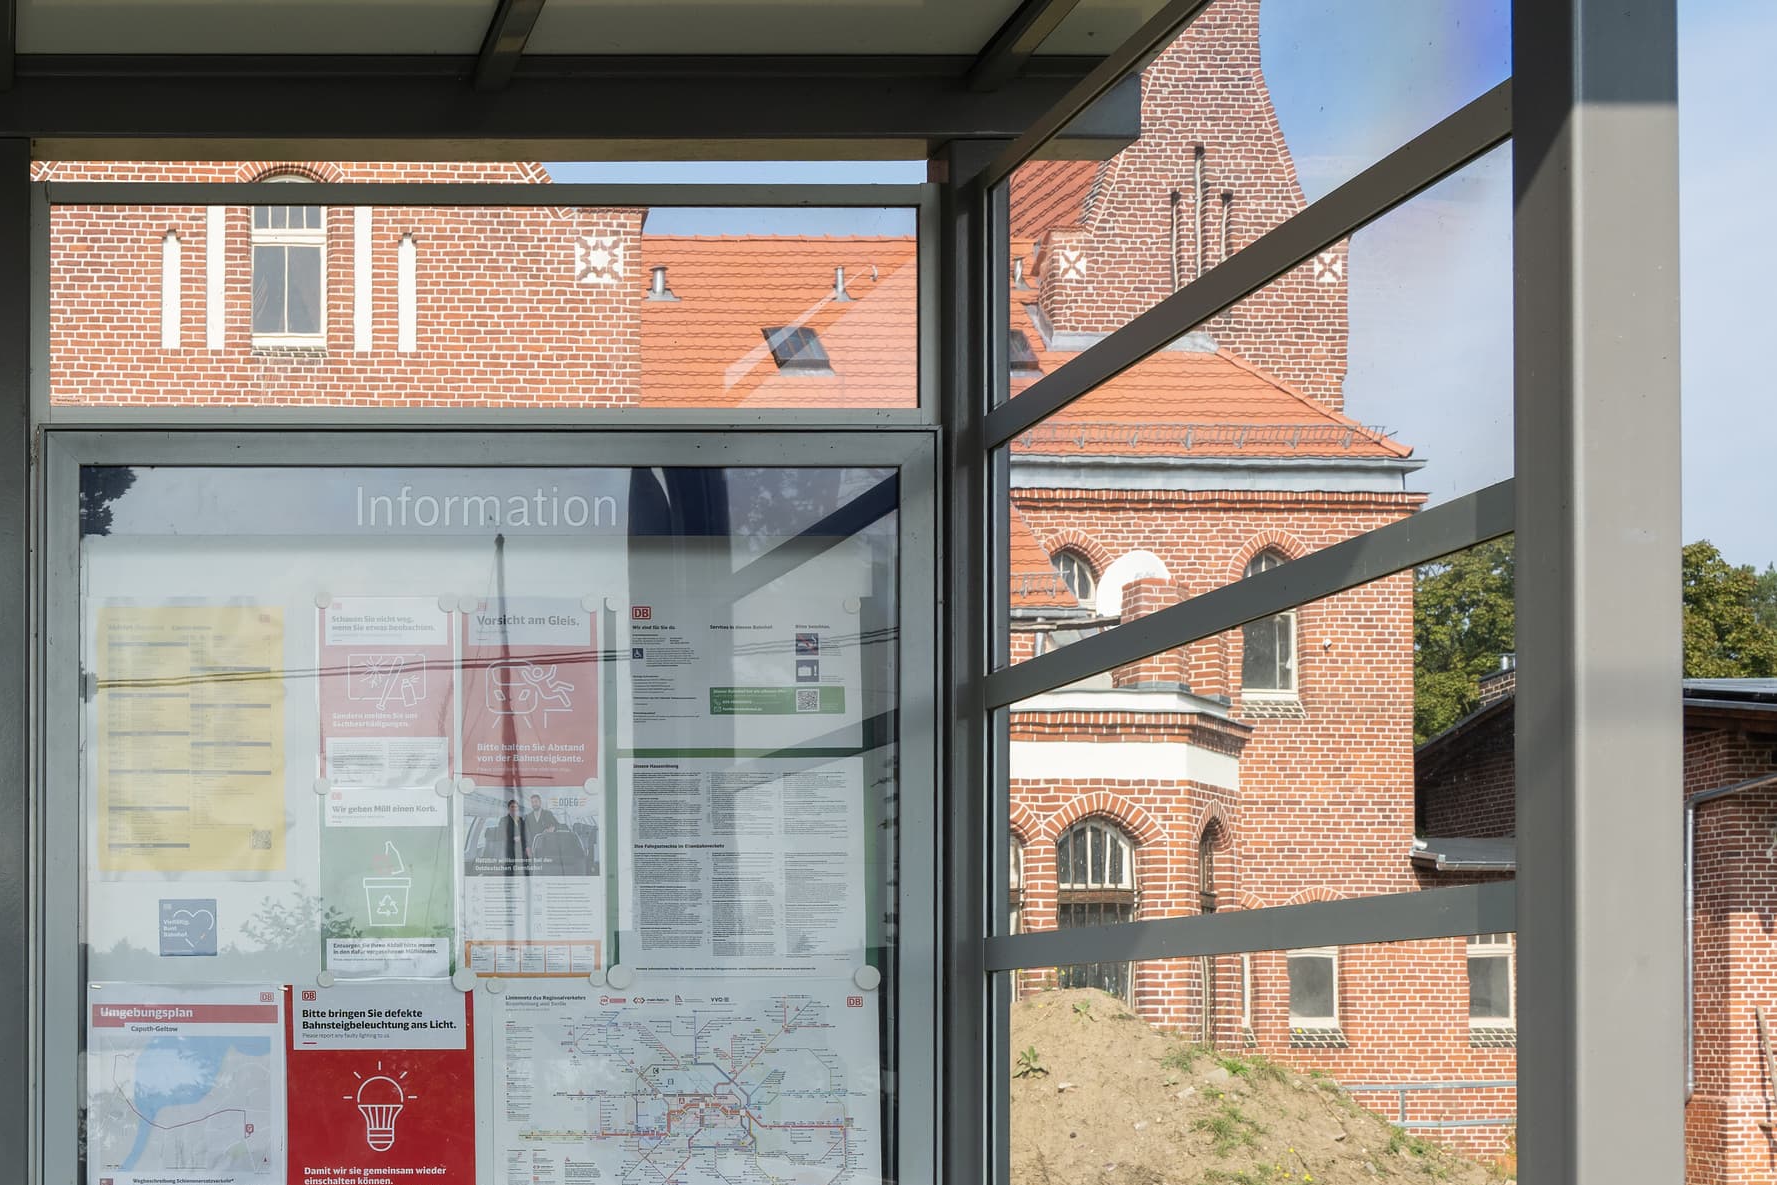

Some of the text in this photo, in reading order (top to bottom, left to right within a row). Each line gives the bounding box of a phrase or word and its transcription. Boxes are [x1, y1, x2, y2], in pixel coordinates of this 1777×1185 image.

[356, 486, 617, 527] Information
[634, 608, 649, 618] DB
[476, 615, 580, 626] Vorsicht am Gleis.
[477, 744, 585, 752] Bitte halten Sie Abstand
[477, 754, 584, 763] von der Bahnsteigkante.
[303, 992, 315, 1000] DB
[848, 998, 862, 1006] DB
[100, 1007, 193, 1019] Umgebungsplan
[302, 1009, 422, 1019] Bitte bringen Sie defekte
[302, 1020, 409, 1031] Bahnsteigbeleuchtung
[429, 1020, 457, 1029] Licht.
[304, 1166, 447, 1176] Damit wir sie gemeinsam wieder
[304, 1176, 394, 1184] einschalten können.
